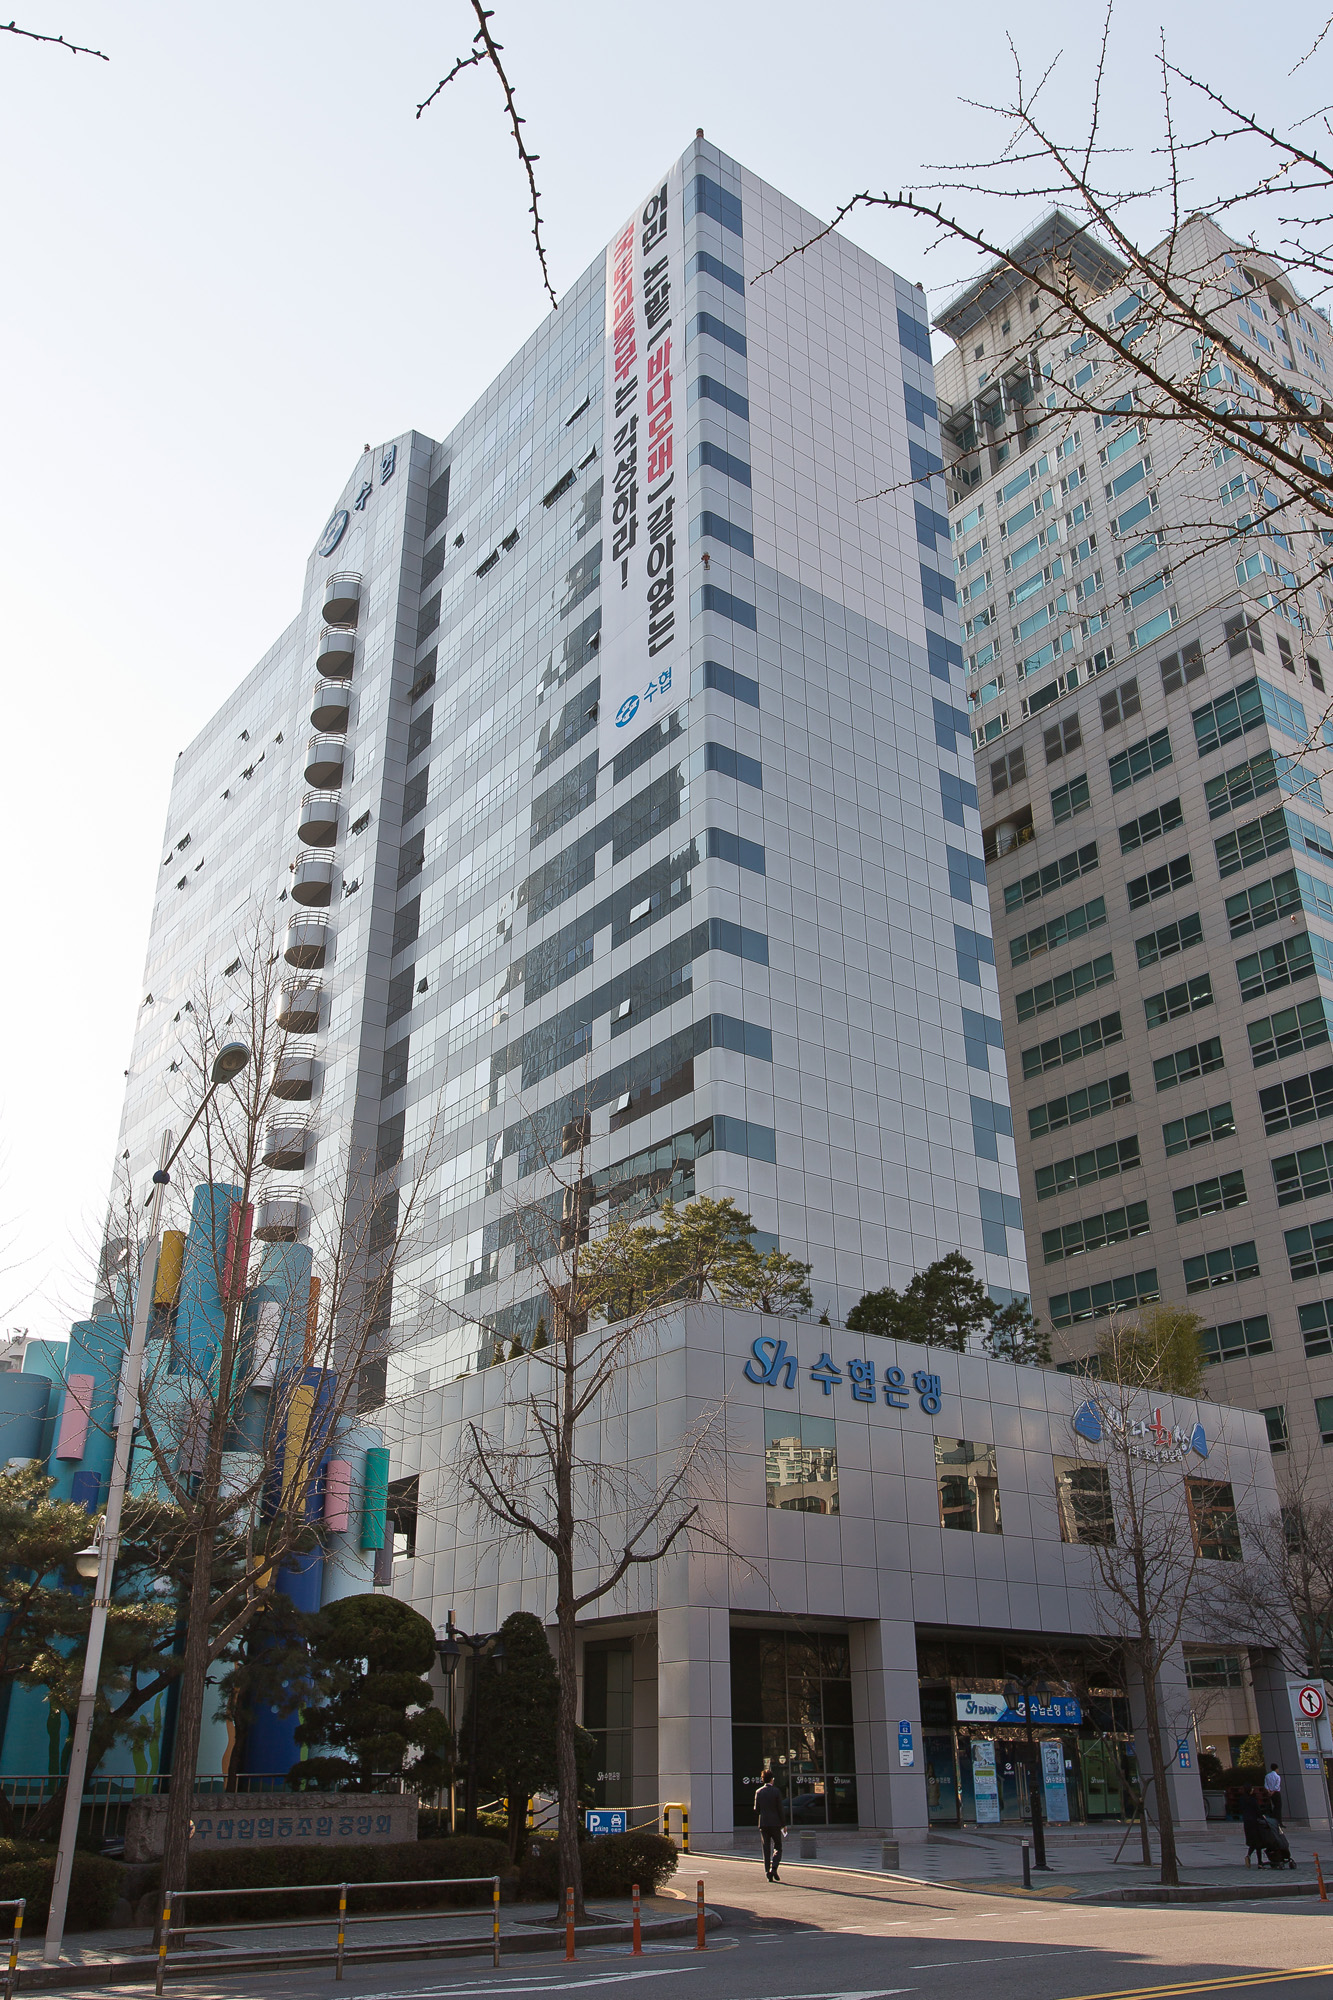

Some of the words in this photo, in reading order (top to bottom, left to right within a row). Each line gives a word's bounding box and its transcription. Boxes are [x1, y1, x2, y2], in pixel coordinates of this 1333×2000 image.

[642, 182, 668, 257] 어민
[613, 221, 639, 419] 국토교통부는
[611, 413, 640, 591] 각성하라!
[643, 666, 673, 703] 수협
[743, 1336, 798, 1390] Sh
[810, 1352, 942, 1415] 수협은행
[978, 1705, 999, 1716] BANK
[196, 1816, 333, 1840] 수산업협동조합
[337, 1814, 392, 1836] 중앙회
